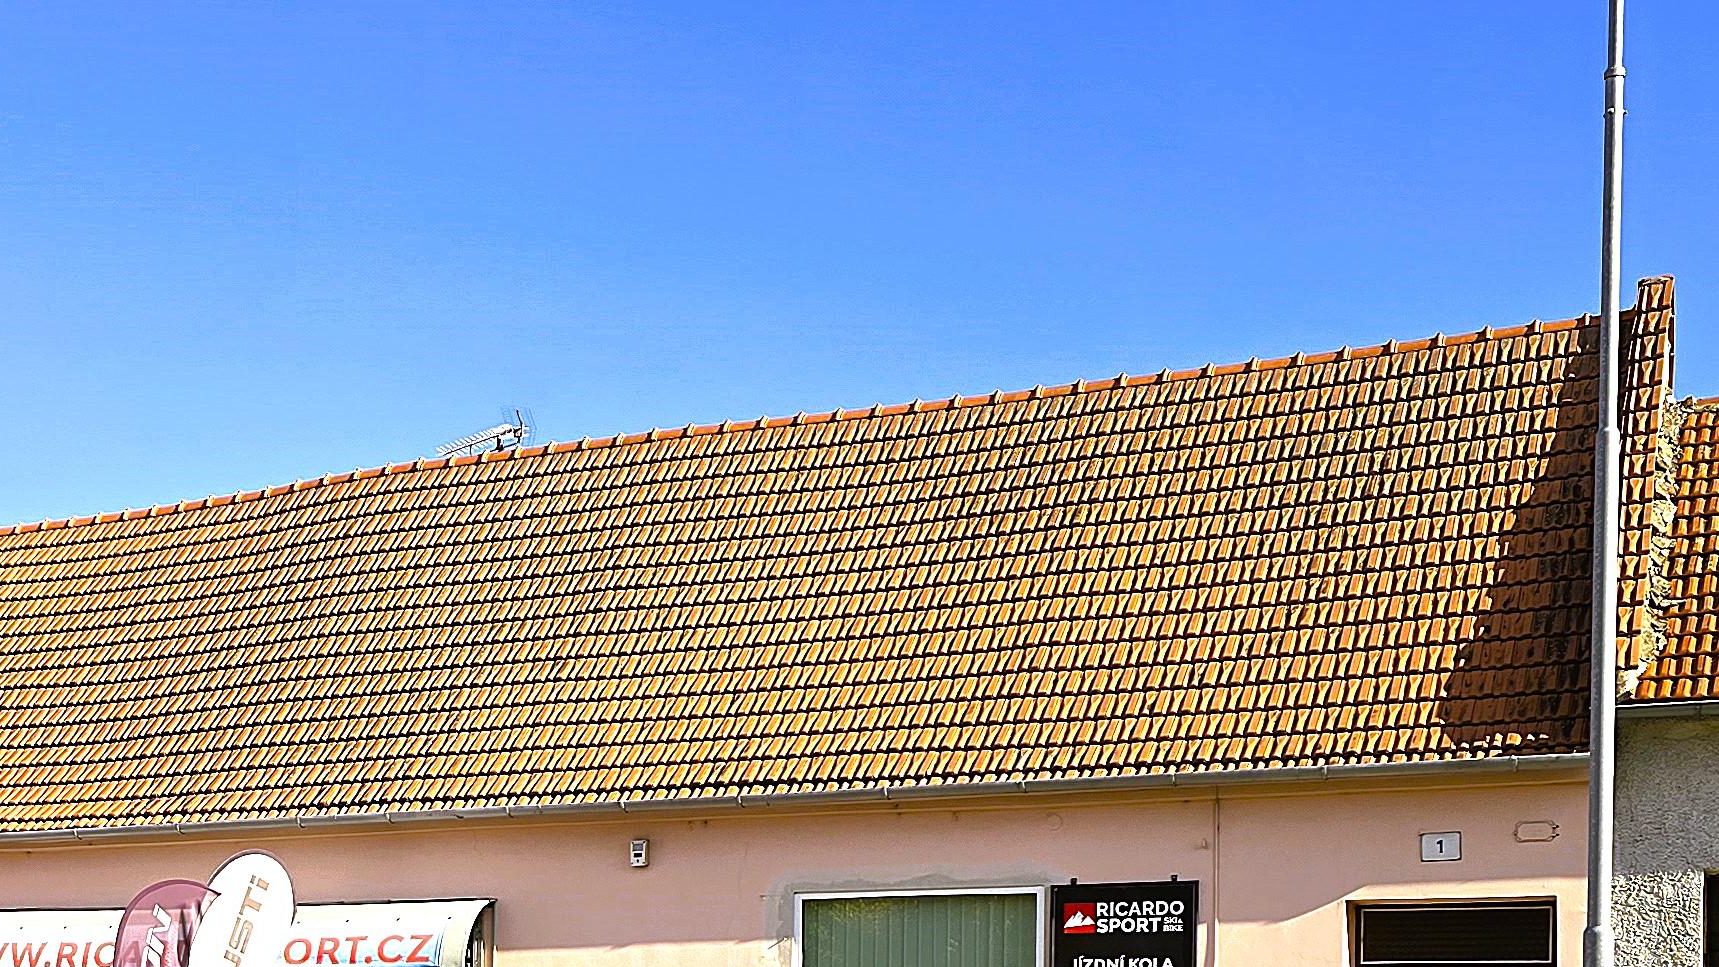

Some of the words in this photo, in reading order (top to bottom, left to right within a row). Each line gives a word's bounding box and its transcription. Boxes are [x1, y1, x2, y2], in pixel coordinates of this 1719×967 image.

[1436, 839, 1444, 854] 1
[1096, 901, 1185, 917] RICARDO
[1096, 917, 1162, 933] SPORT
